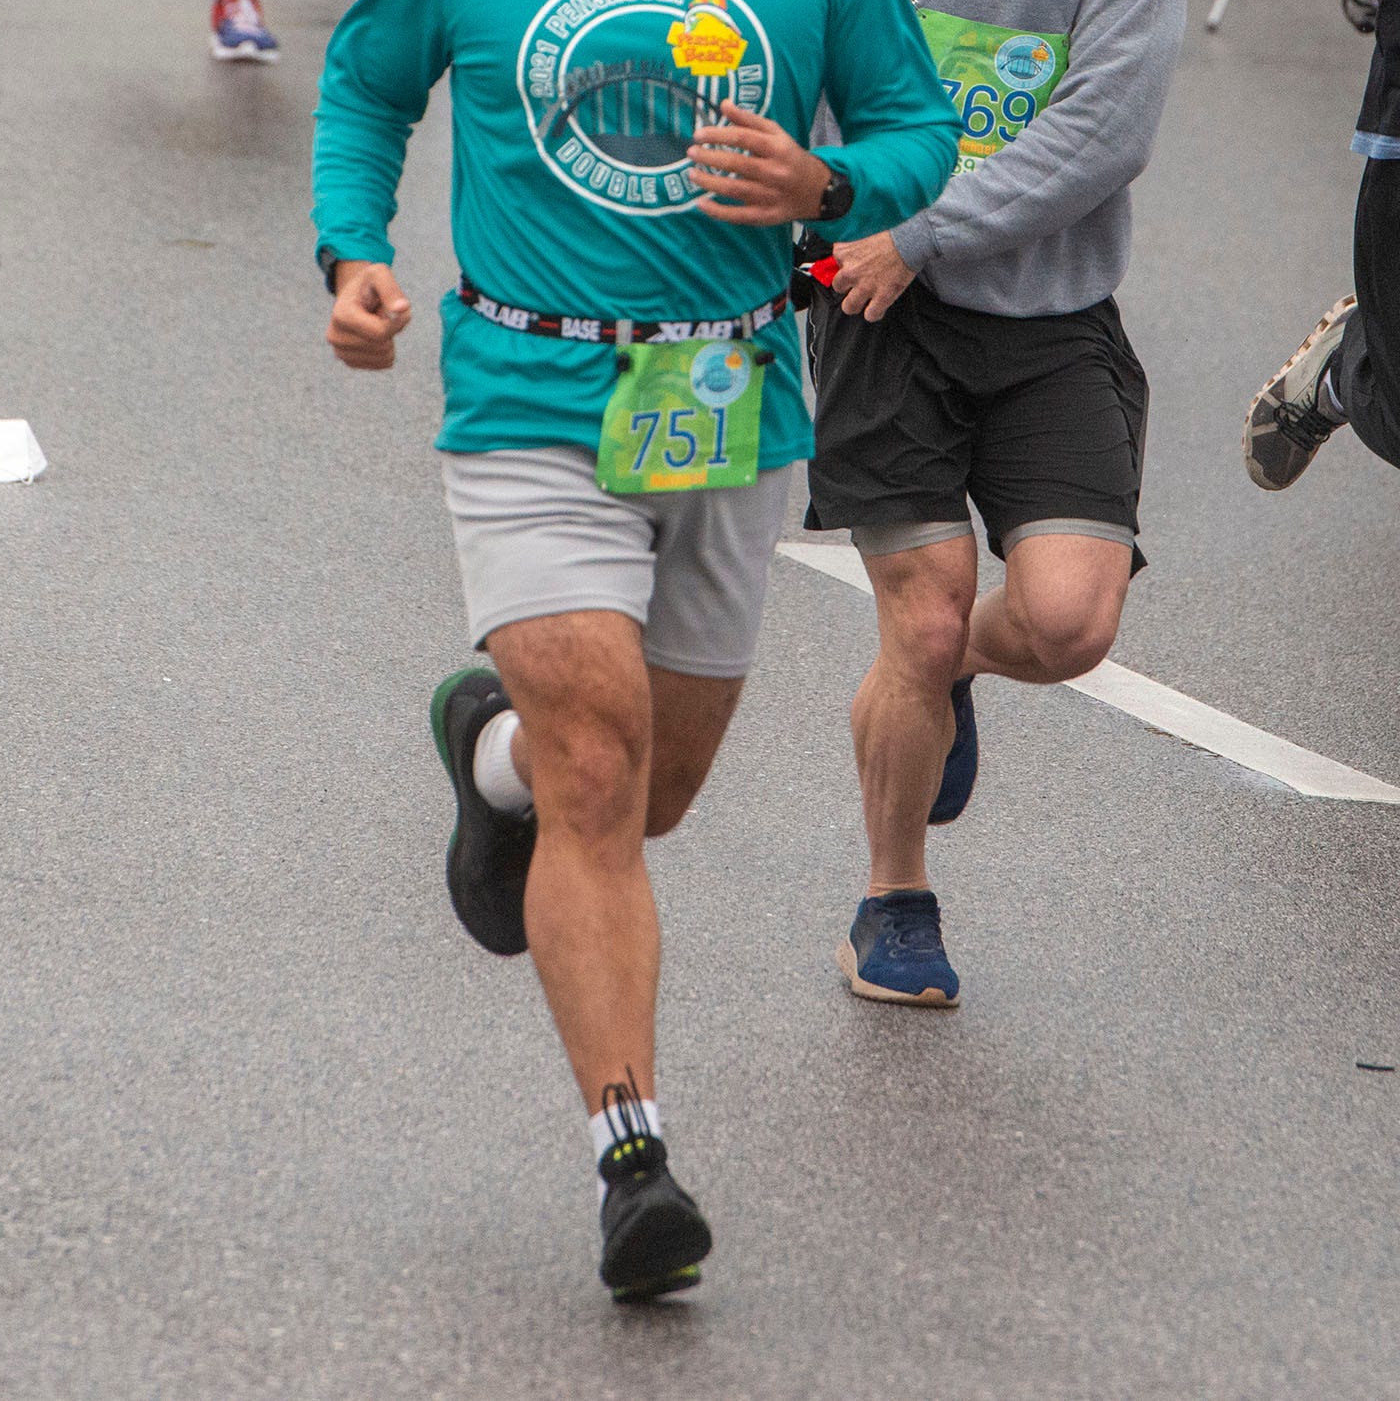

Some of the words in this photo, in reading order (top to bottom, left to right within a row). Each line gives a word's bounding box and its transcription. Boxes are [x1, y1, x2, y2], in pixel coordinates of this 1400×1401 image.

[556, 137, 657, 204] DOUBLE
[561, 317, 601, 343] BASE
[629, 407, 729, 473] 751
